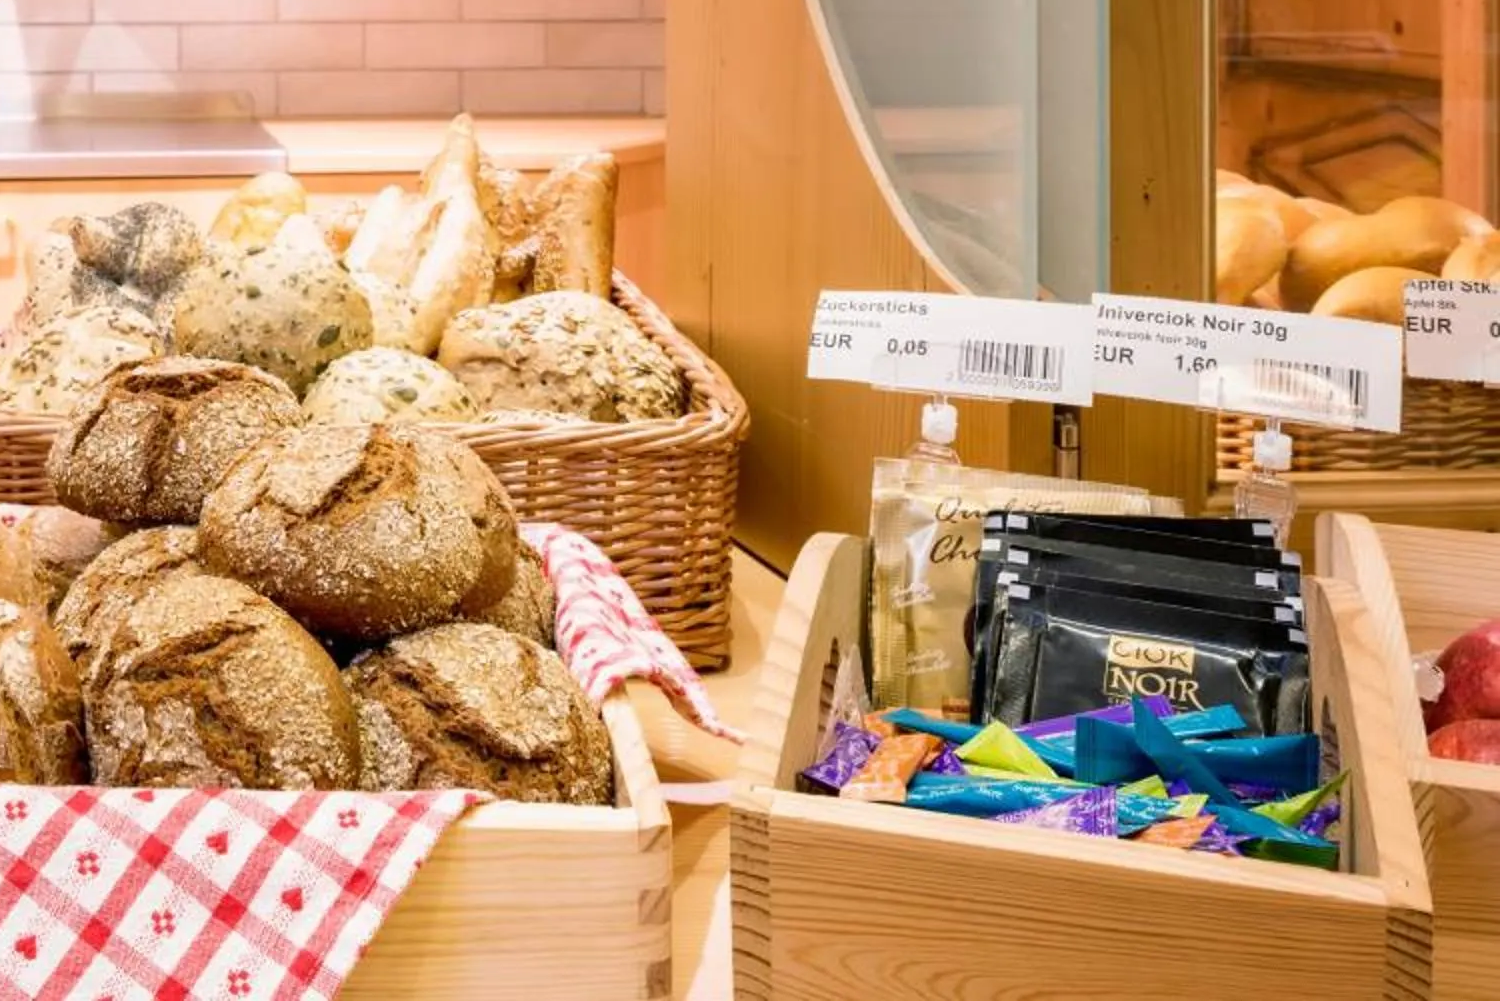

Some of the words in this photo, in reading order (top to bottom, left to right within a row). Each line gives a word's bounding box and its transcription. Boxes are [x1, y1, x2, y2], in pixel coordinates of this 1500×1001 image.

[817, 299, 929, 316] Zuckersticks
[1203, 314, 1246, 334] Noir
[1252, 320, 1288, 342] 30g
[1405, 316, 1453, 335] EUR
[811, 332, 853, 350] EUR
[887, 337, 929, 356] 0,05
[1108, 666, 1206, 712] NOIR
